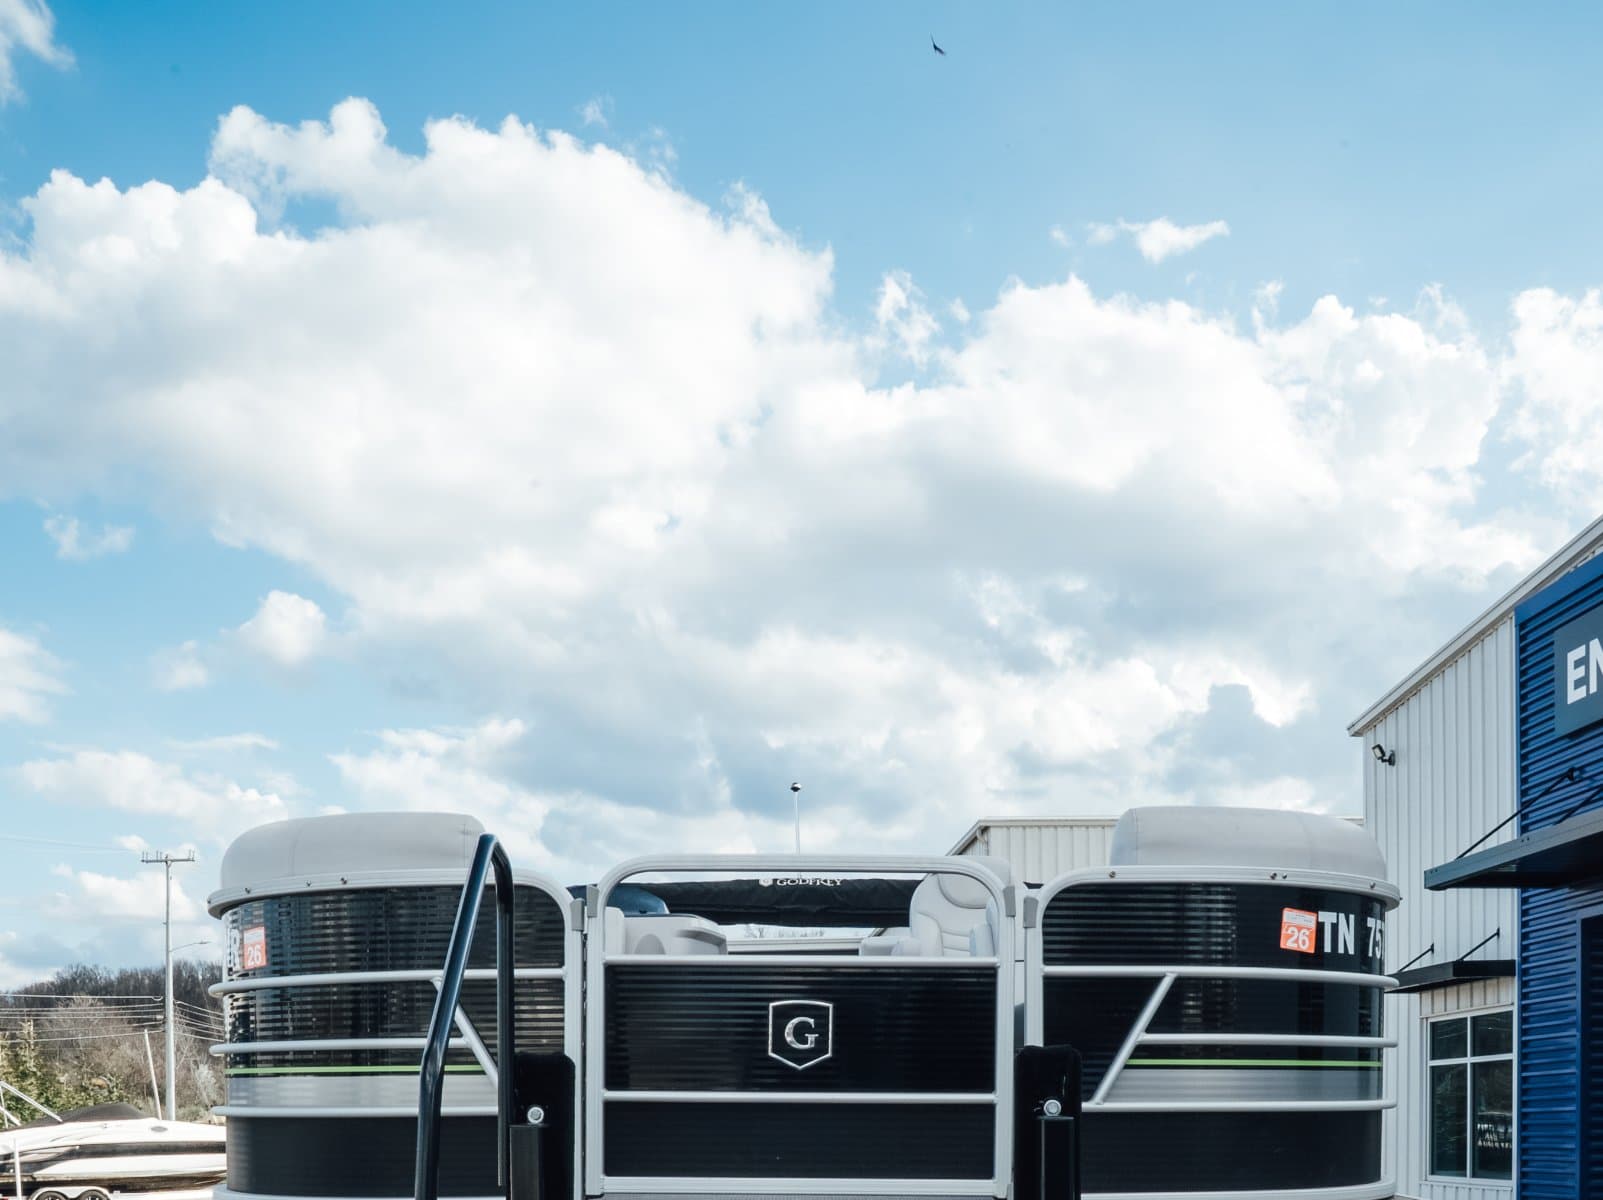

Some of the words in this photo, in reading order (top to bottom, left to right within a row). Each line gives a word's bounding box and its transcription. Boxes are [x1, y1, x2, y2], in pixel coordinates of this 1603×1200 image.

[1286, 926, 1310, 950] 26
[1318, 910, 1355, 955] TN
[247, 944, 262, 967] 26
[784, 1016, 820, 1050] G
